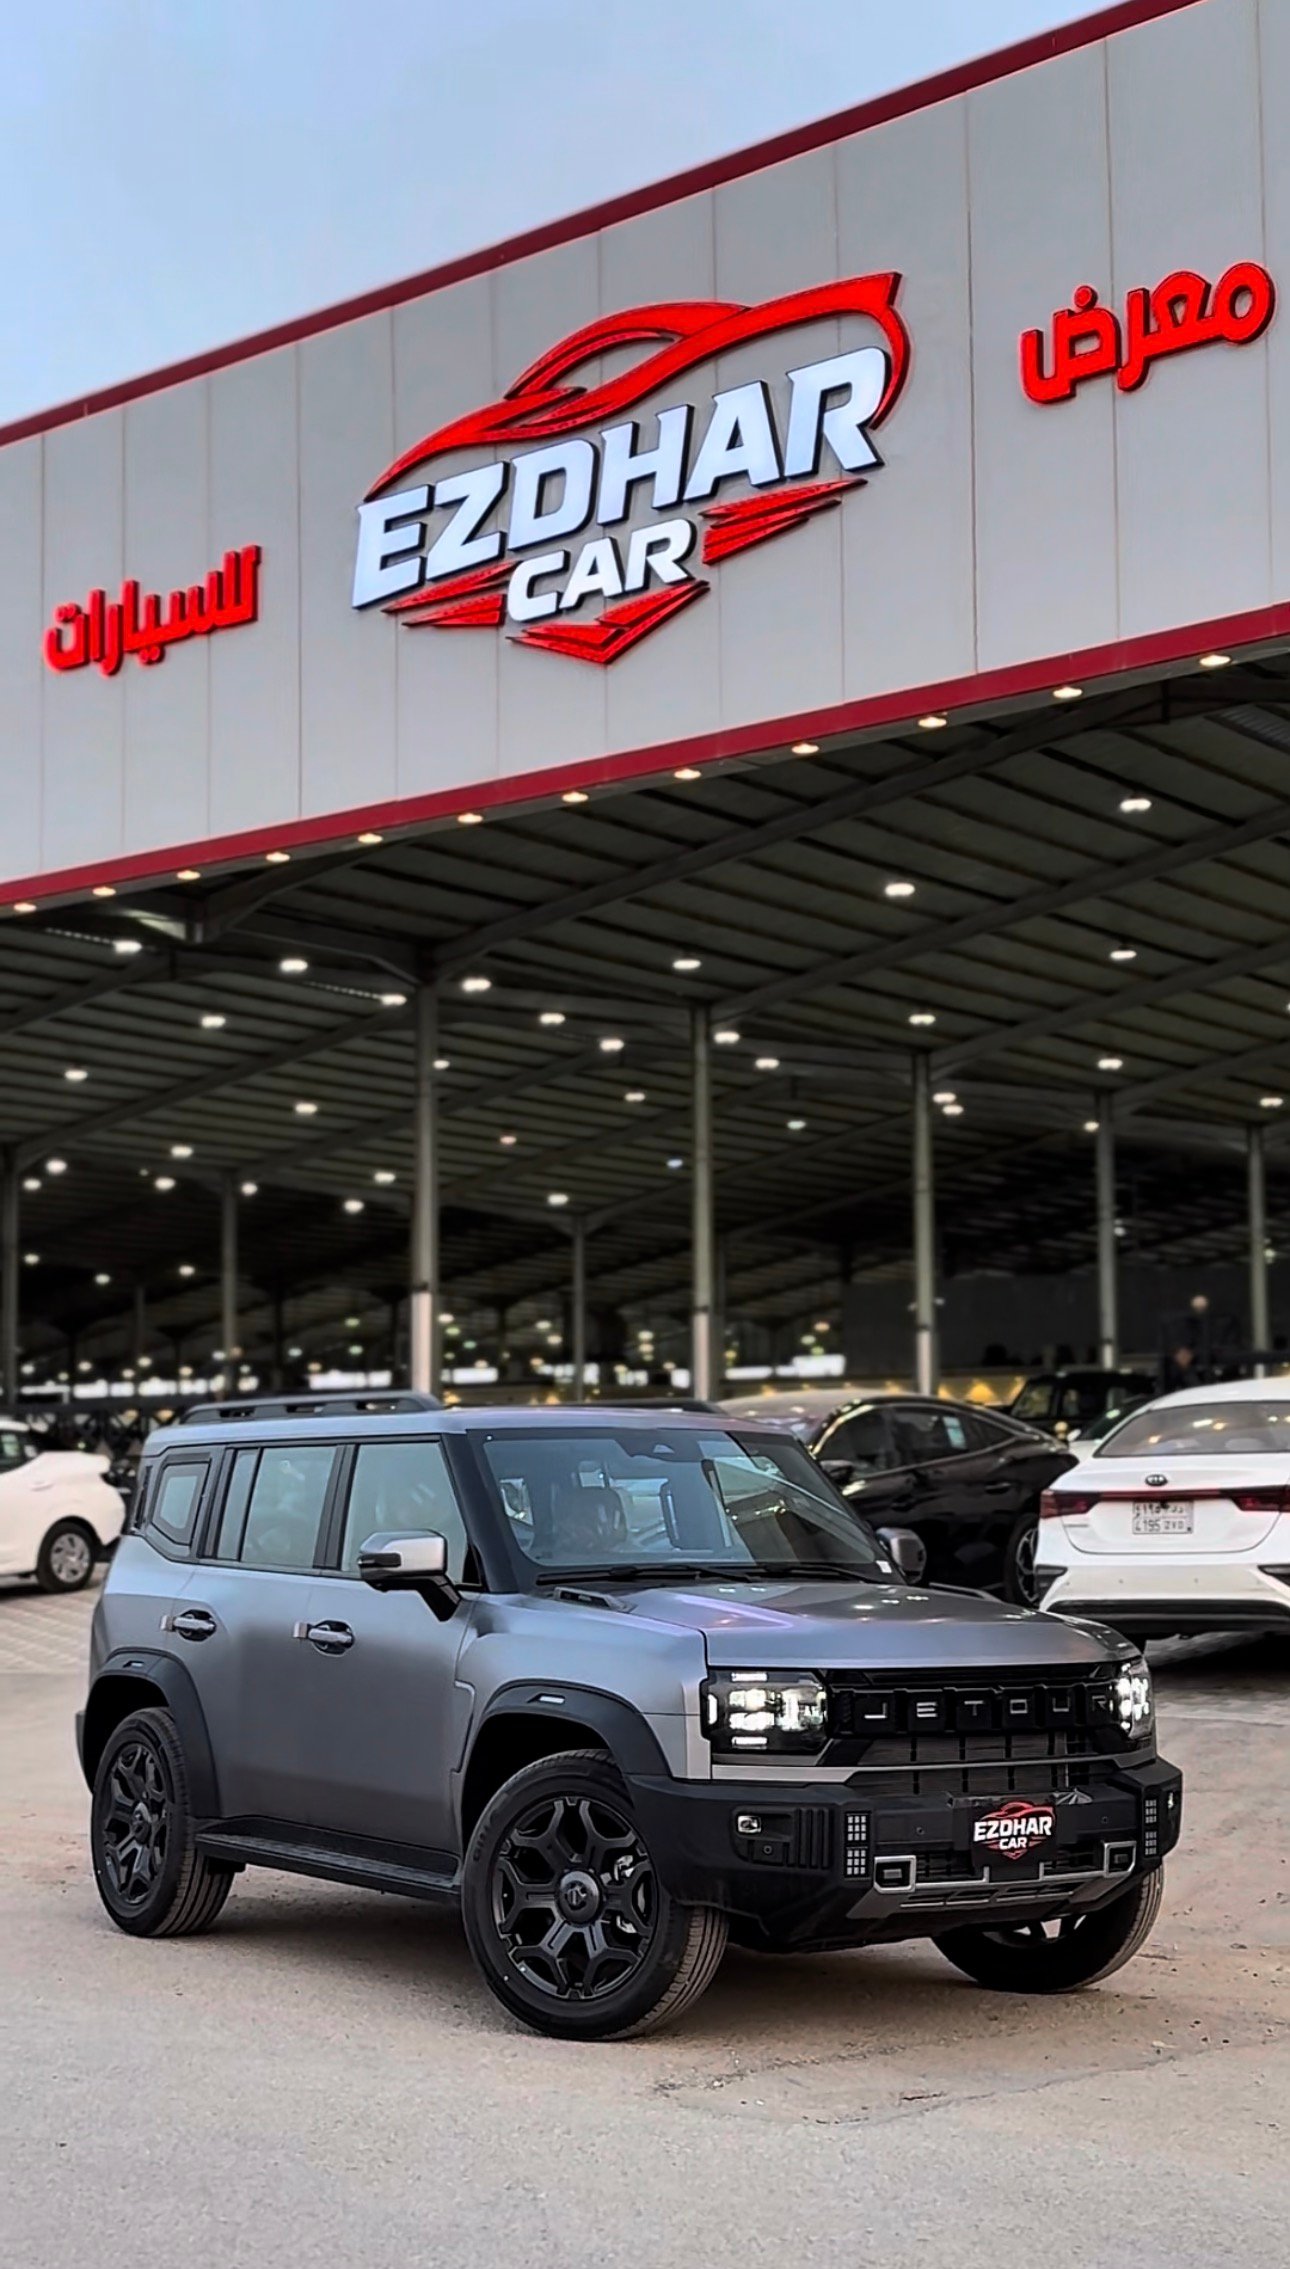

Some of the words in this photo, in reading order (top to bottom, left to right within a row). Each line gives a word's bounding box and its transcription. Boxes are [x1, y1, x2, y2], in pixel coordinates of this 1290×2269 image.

[1020, 261, 1276, 405] معرض
[352, 346, 885, 611] EZDHAR
[507, 518, 697, 622] CAR
[863, 1694, 1107, 1719] JETOUR
[973, 1816, 1053, 1842] EZDHAR
[999, 1836, 1028, 1850] CAR
